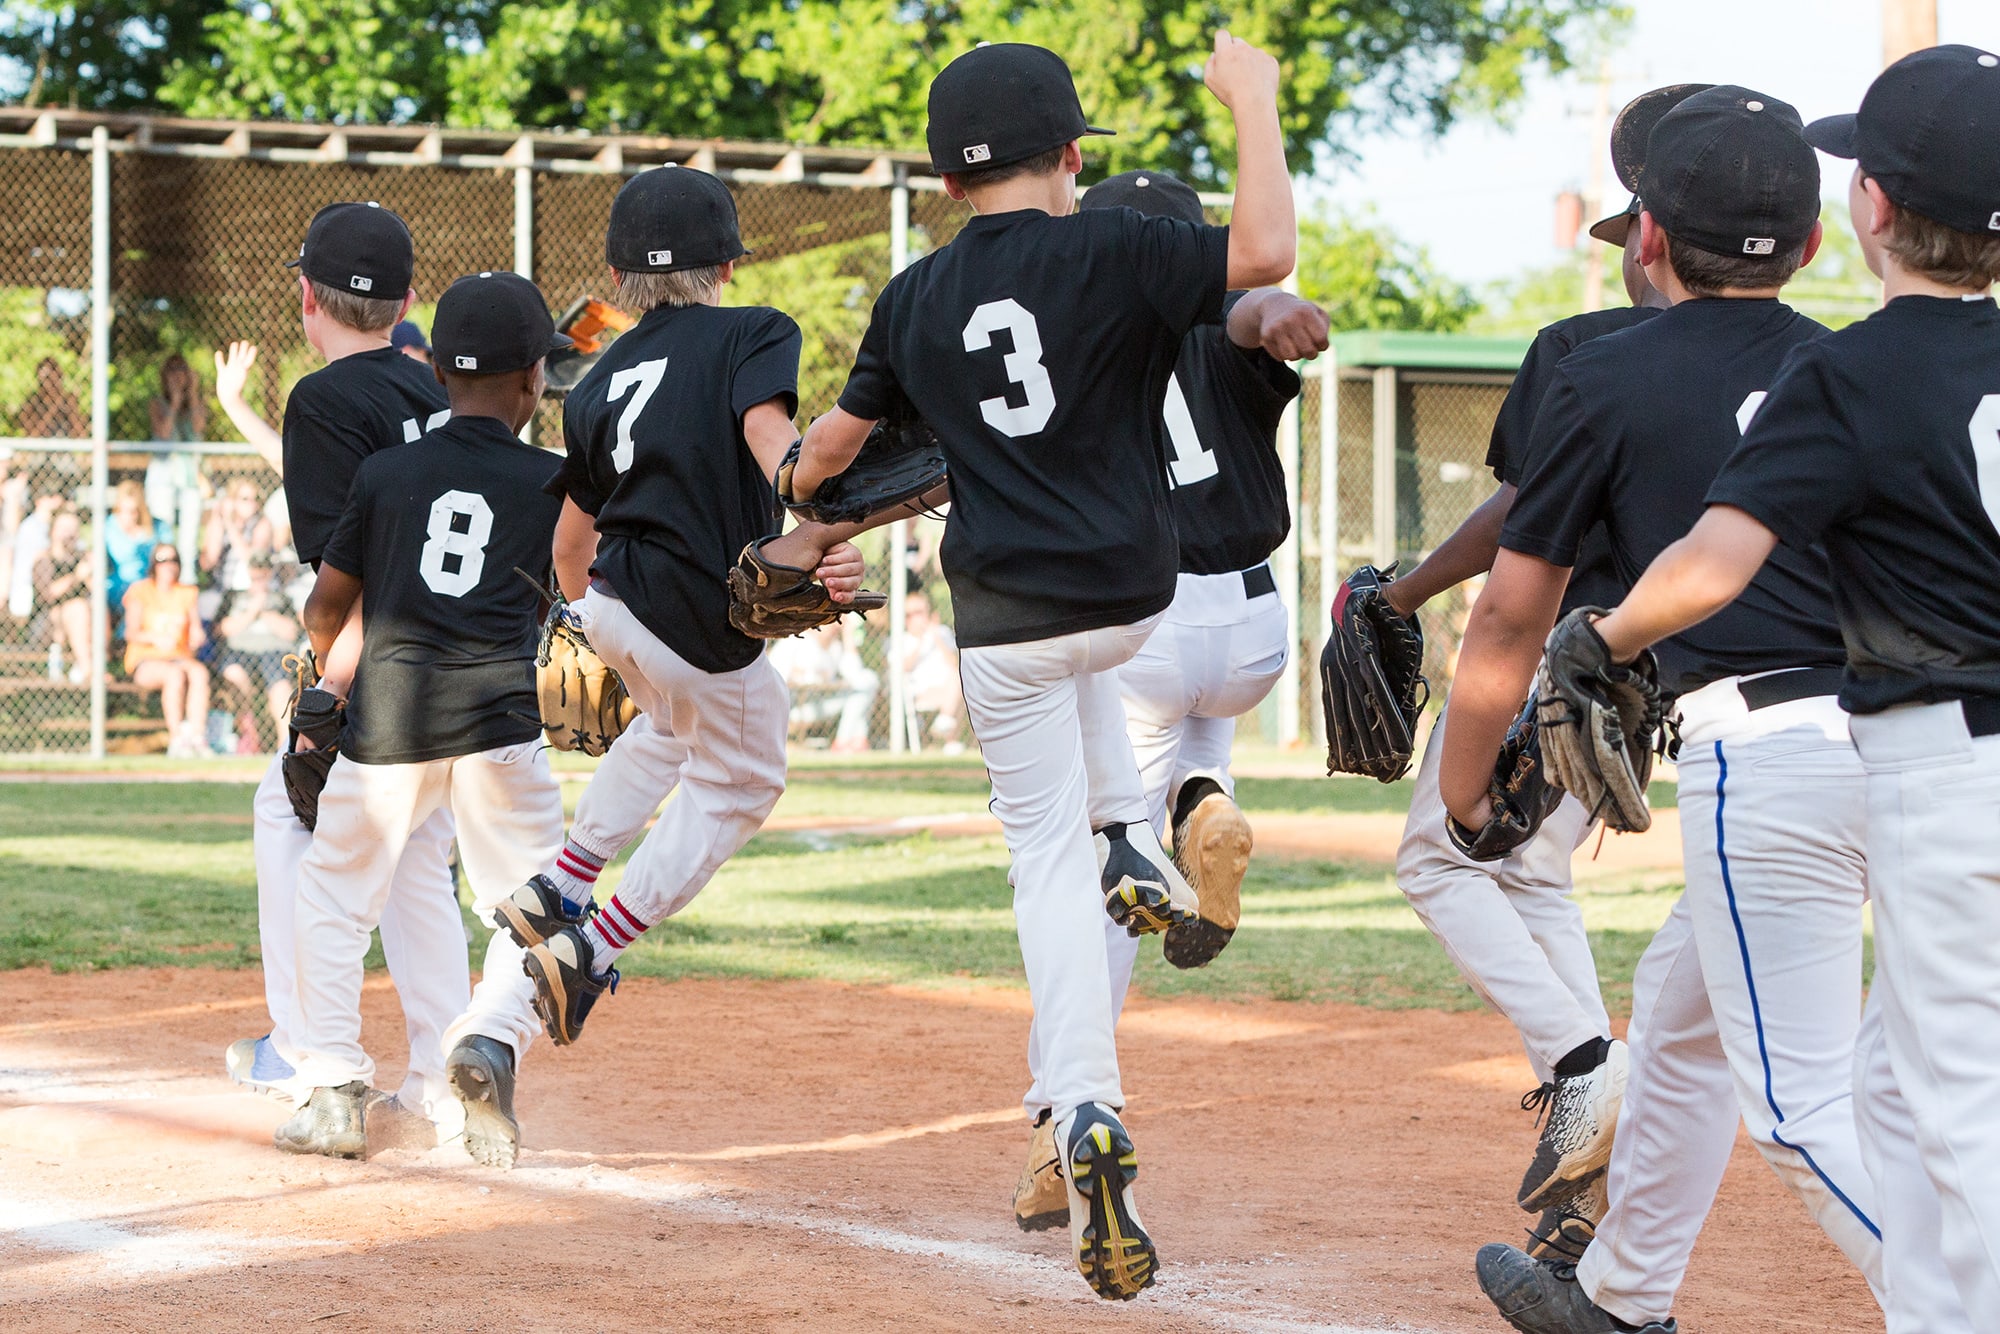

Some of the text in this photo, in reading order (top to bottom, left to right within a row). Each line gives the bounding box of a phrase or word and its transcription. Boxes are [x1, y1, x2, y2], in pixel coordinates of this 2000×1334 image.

[606, 356, 669, 475] 7
[962, 297, 1057, 438] 3
[419, 489, 495, 598] 8
